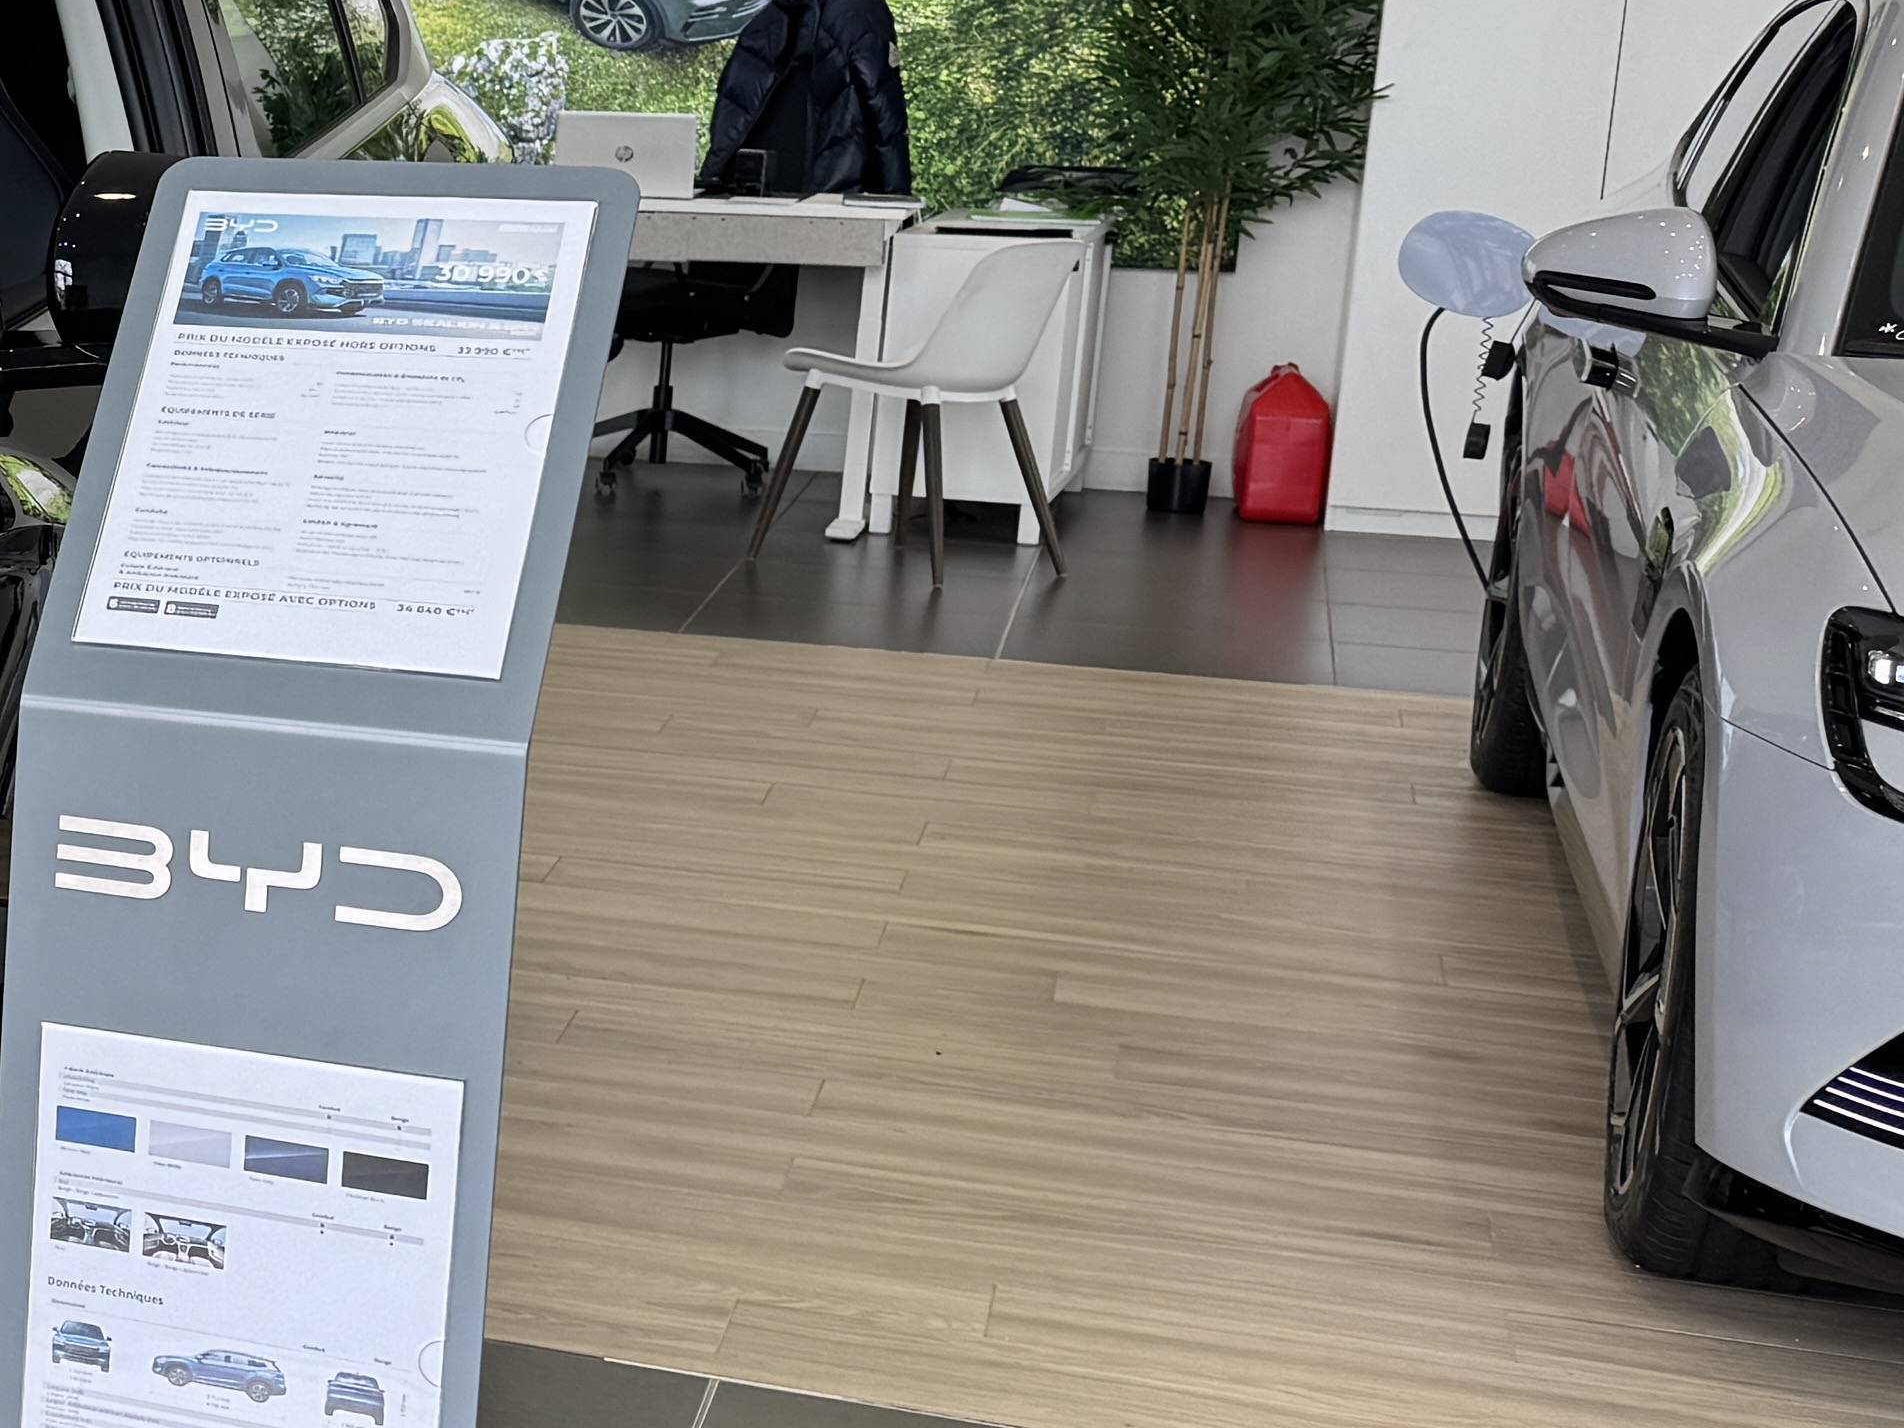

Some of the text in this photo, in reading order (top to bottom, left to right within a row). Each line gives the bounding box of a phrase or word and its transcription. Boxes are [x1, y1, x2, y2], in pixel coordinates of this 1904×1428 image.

[203, 217, 279, 233] BYD
[209, 333, 228, 343] DU
[113, 580, 142, 592] PRIX
[146, 583, 165, 594] DU
[279, 593, 314, 605] AVEC
[54, 814, 463, 932] BYD
[47, 1276, 97, 1294] Données
[99, 1284, 165, 1306] Techniques
